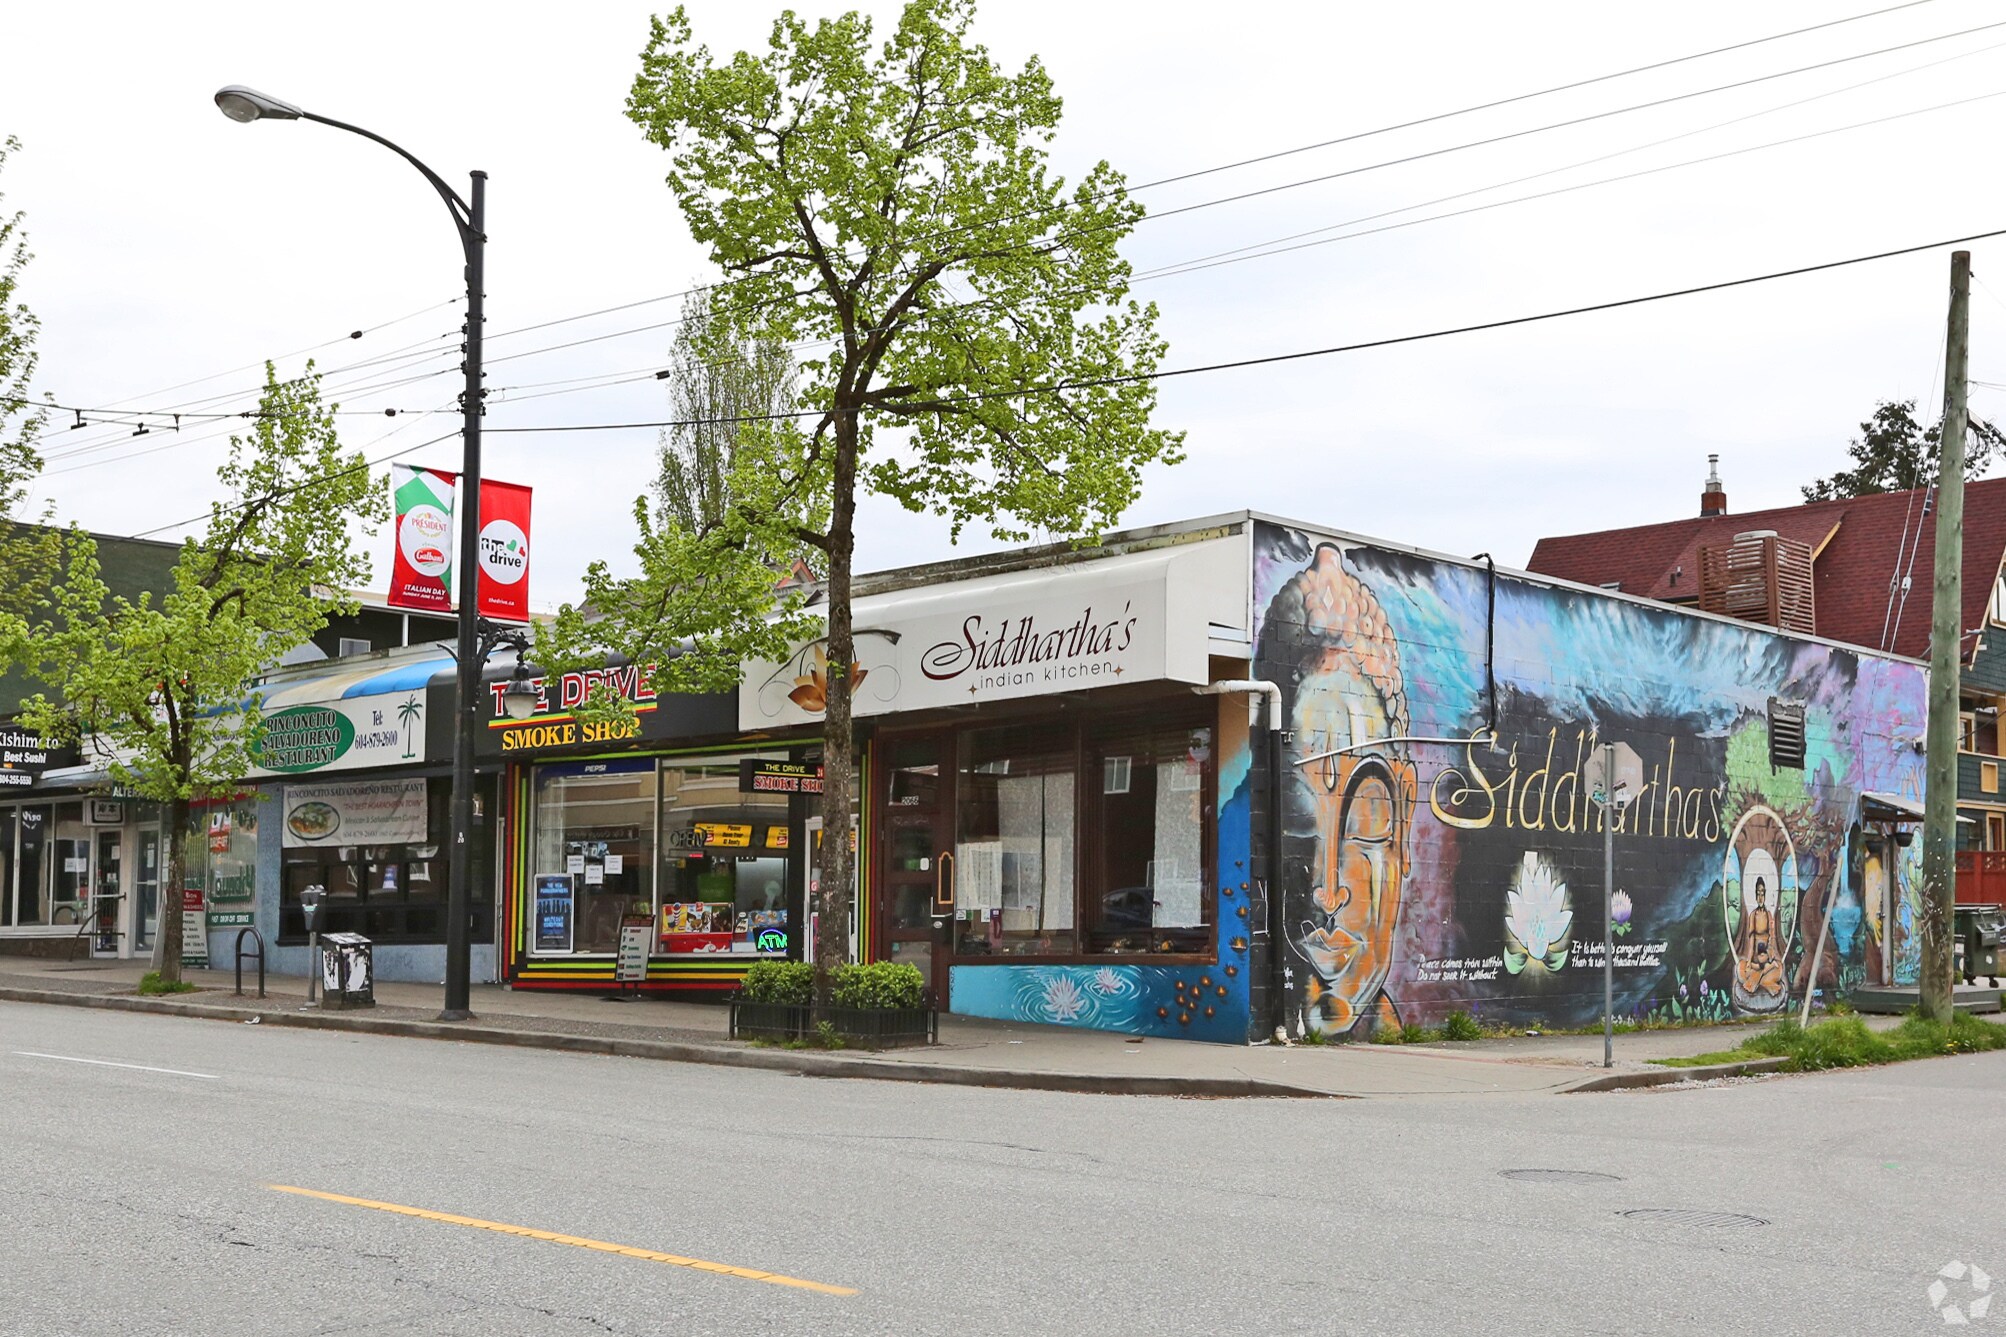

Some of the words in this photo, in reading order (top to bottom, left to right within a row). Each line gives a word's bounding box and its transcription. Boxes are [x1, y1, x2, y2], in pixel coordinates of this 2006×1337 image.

[481, 537, 505, 551] the
[489, 552, 522, 568] drive
[404, 584, 432, 595] ITALIAN
[432, 587, 446, 596] DAY
[488, 597, 515, 606] thedrive.ca
[920, 600, 1138, 681] Siddhartha's
[980, 671, 1034, 690] indian
[1043, 660, 1113, 682] kitchen
[490, 675, 549, 717] TE
[265, 709, 337, 734] RINCONCITO
[372, 710, 384, 727] Tel:
[0, 731, 59, 749] Kishimto
[260, 727, 341, 751] SALVADORENO
[354, 730, 398, 750] 604-879-2600
[502, 723, 576, 751] SMOKE
[4, 751, 23, 762] Best
[24, 752, 47, 763] Sushi
[263, 746, 337, 769] RESTAURANT
[584, 764, 607, 773] PEPSI
[765, 763, 780, 772] THE
[783, 765, 805, 774] DRIVE
[754, 775, 799, 792] SMOKE
[800, 778, 824, 793] SHO
[287, 787, 331, 799] RINCONCITO
[670, 831, 704, 848] OPEN
[758, 934, 787, 950] ATM
[1571, 940, 1582, 954] It
[1441, 959, 1462, 968] comes
[1463, 958, 1480, 968] from
[1481, 955, 1503, 968] within
[1571, 955, 1587, 967] than
[1416, 968, 1428, 980] Do
[1428, 970, 1442, 980] not
